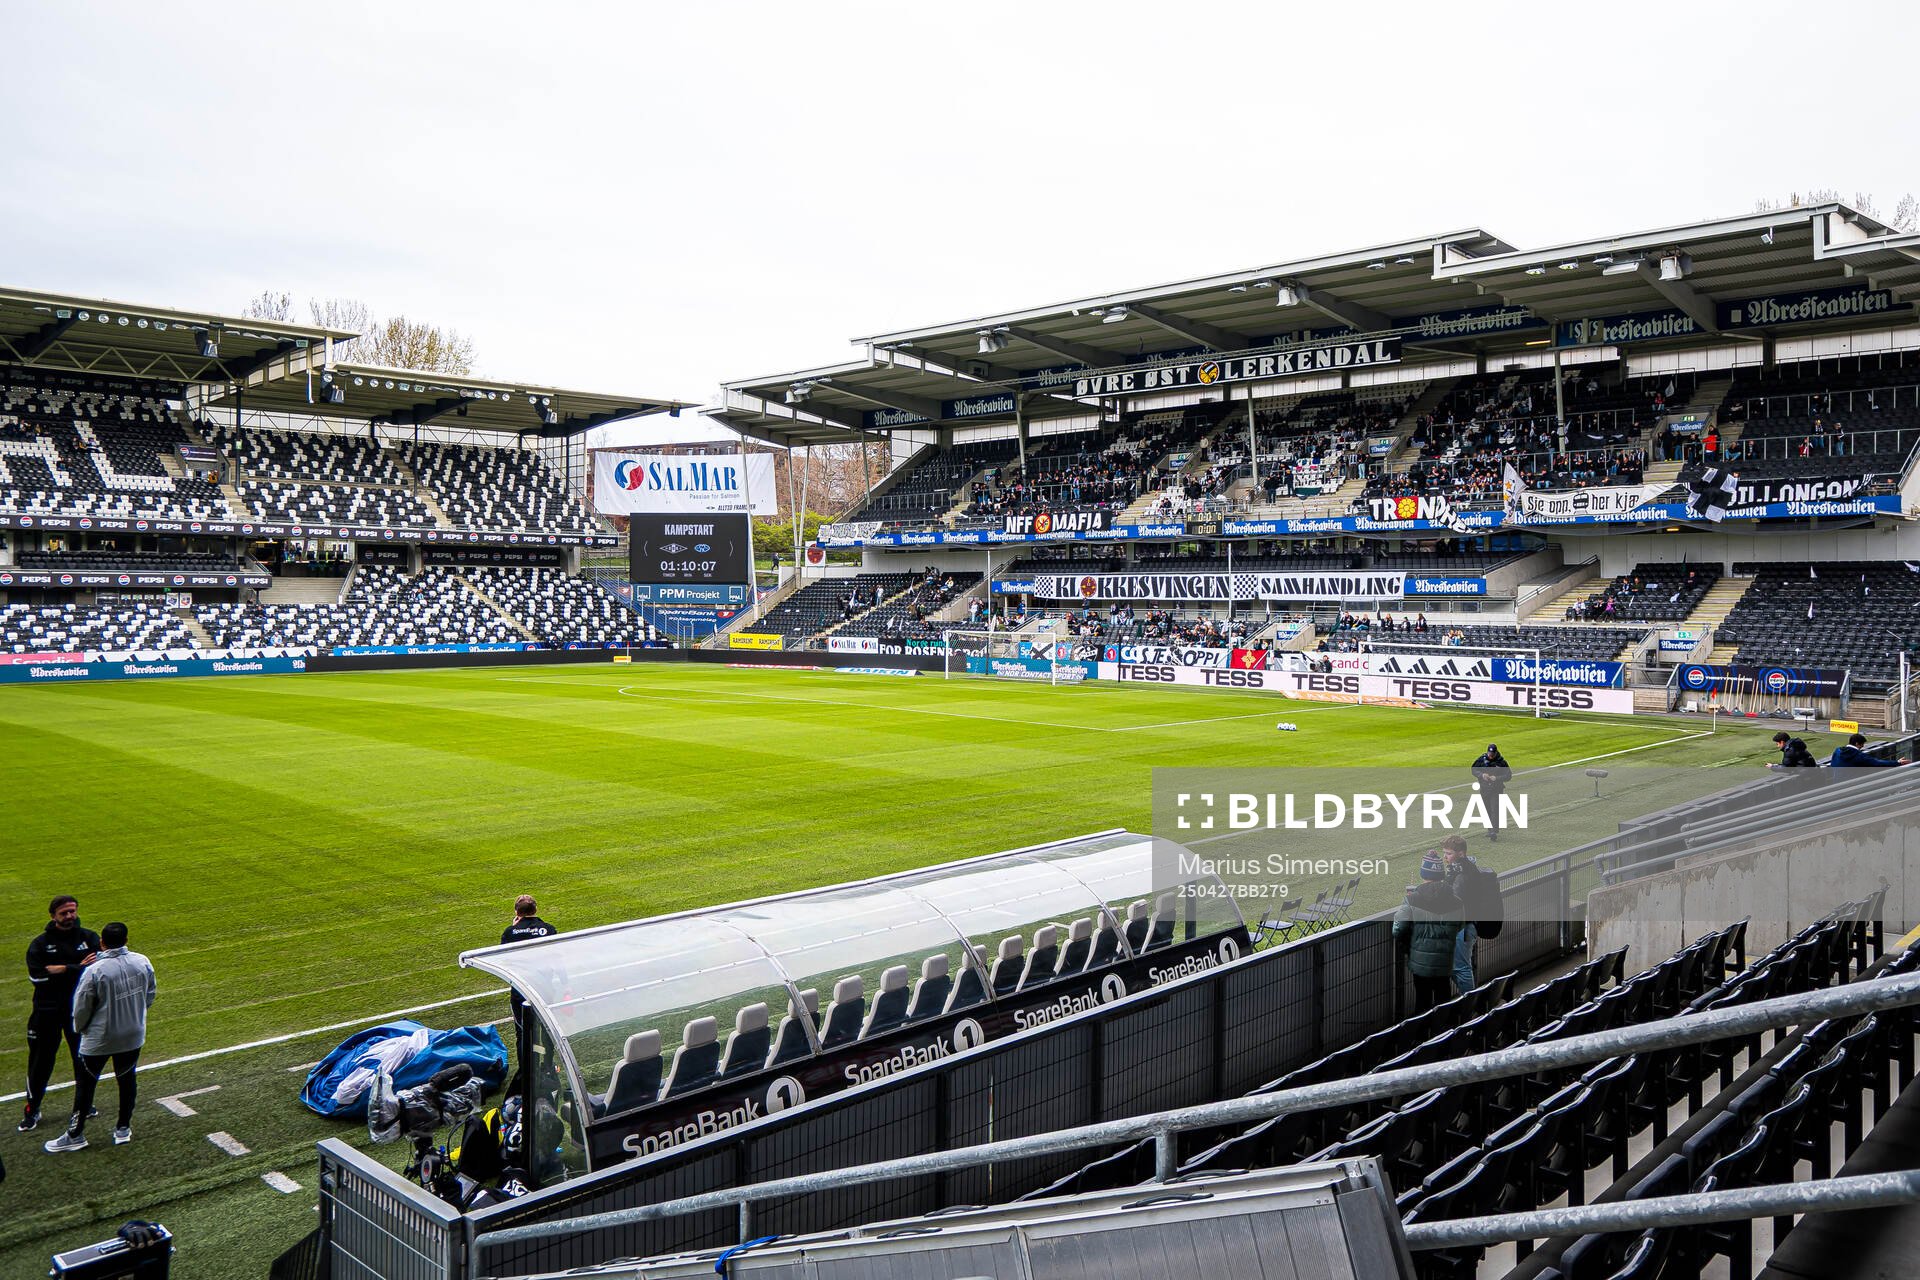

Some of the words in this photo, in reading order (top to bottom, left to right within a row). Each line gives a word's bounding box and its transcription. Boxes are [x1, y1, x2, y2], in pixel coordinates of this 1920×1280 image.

[1748, 290, 1888, 324] Adresseavisen
[1076, 373, 1134, 396] ØVRE
[1144, 366, 1190, 388] ØST
[954, 398, 1012, 417] Adresseavisen
[664, 524, 714, 536] KAMPSTART
[1006, 516, 1032, 534] NFF
[1052, 512, 1102, 531] MAFIA
[660, 561, 716, 571] 01:10:07
[660, 589, 684, 598] PPM
[687, 590, 720, 600] Prosjekt
[1261, 578, 1400, 595] SAMHANDLING
[1415, 580, 1478, 593] Adresseavisen
[1118, 665, 1175, 682] TESS
[1201, 669, 1264, 687] TESS
[1506, 659, 1606, 683] Adresseavisen
[1292, 674, 1359, 693] TESS
[1393, 679, 1471, 701] TESS
[1506, 687, 1593, 709] TESS
[1149, 950, 1218, 986] SpareBank
[1014, 988, 1100, 1032] SpareBank
[844, 1036, 950, 1088] SpareBank
[622, 1098, 760, 1162] SpareBank
